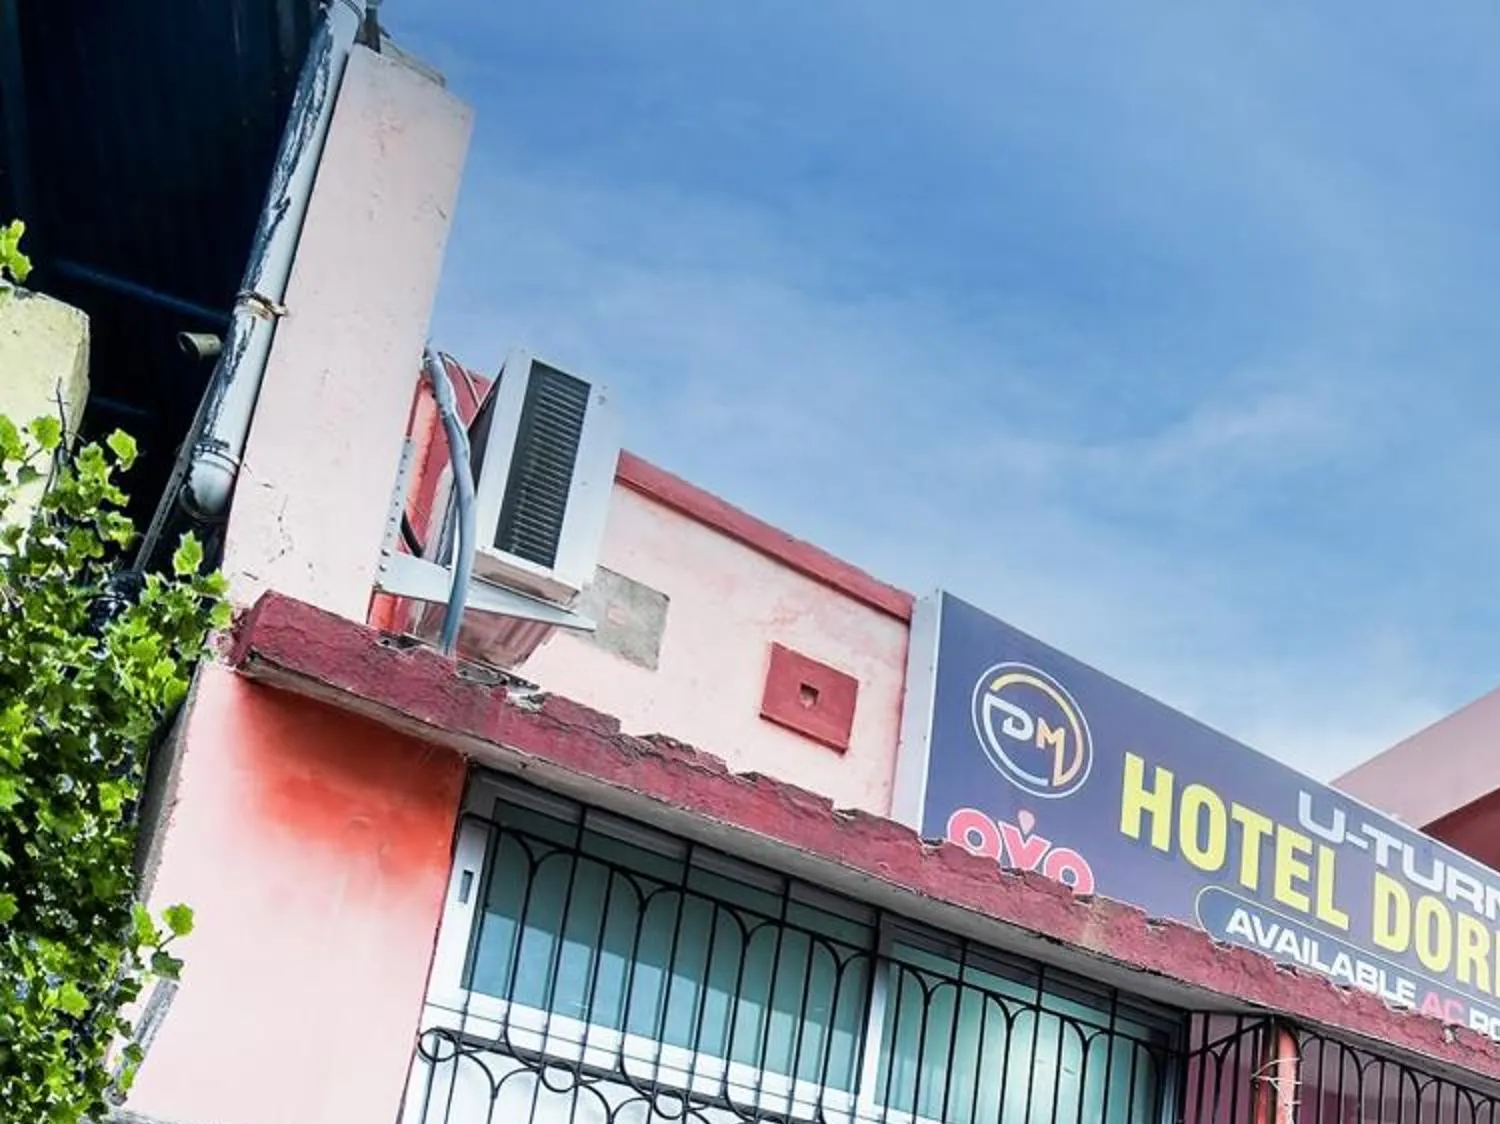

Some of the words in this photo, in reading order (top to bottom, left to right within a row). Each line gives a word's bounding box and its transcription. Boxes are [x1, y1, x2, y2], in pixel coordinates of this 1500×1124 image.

[1120, 751, 1349, 931] HOTEL
[1225, 907, 1417, 1009] AVAILABLE
[1421, 991, 1466, 1025] AC
